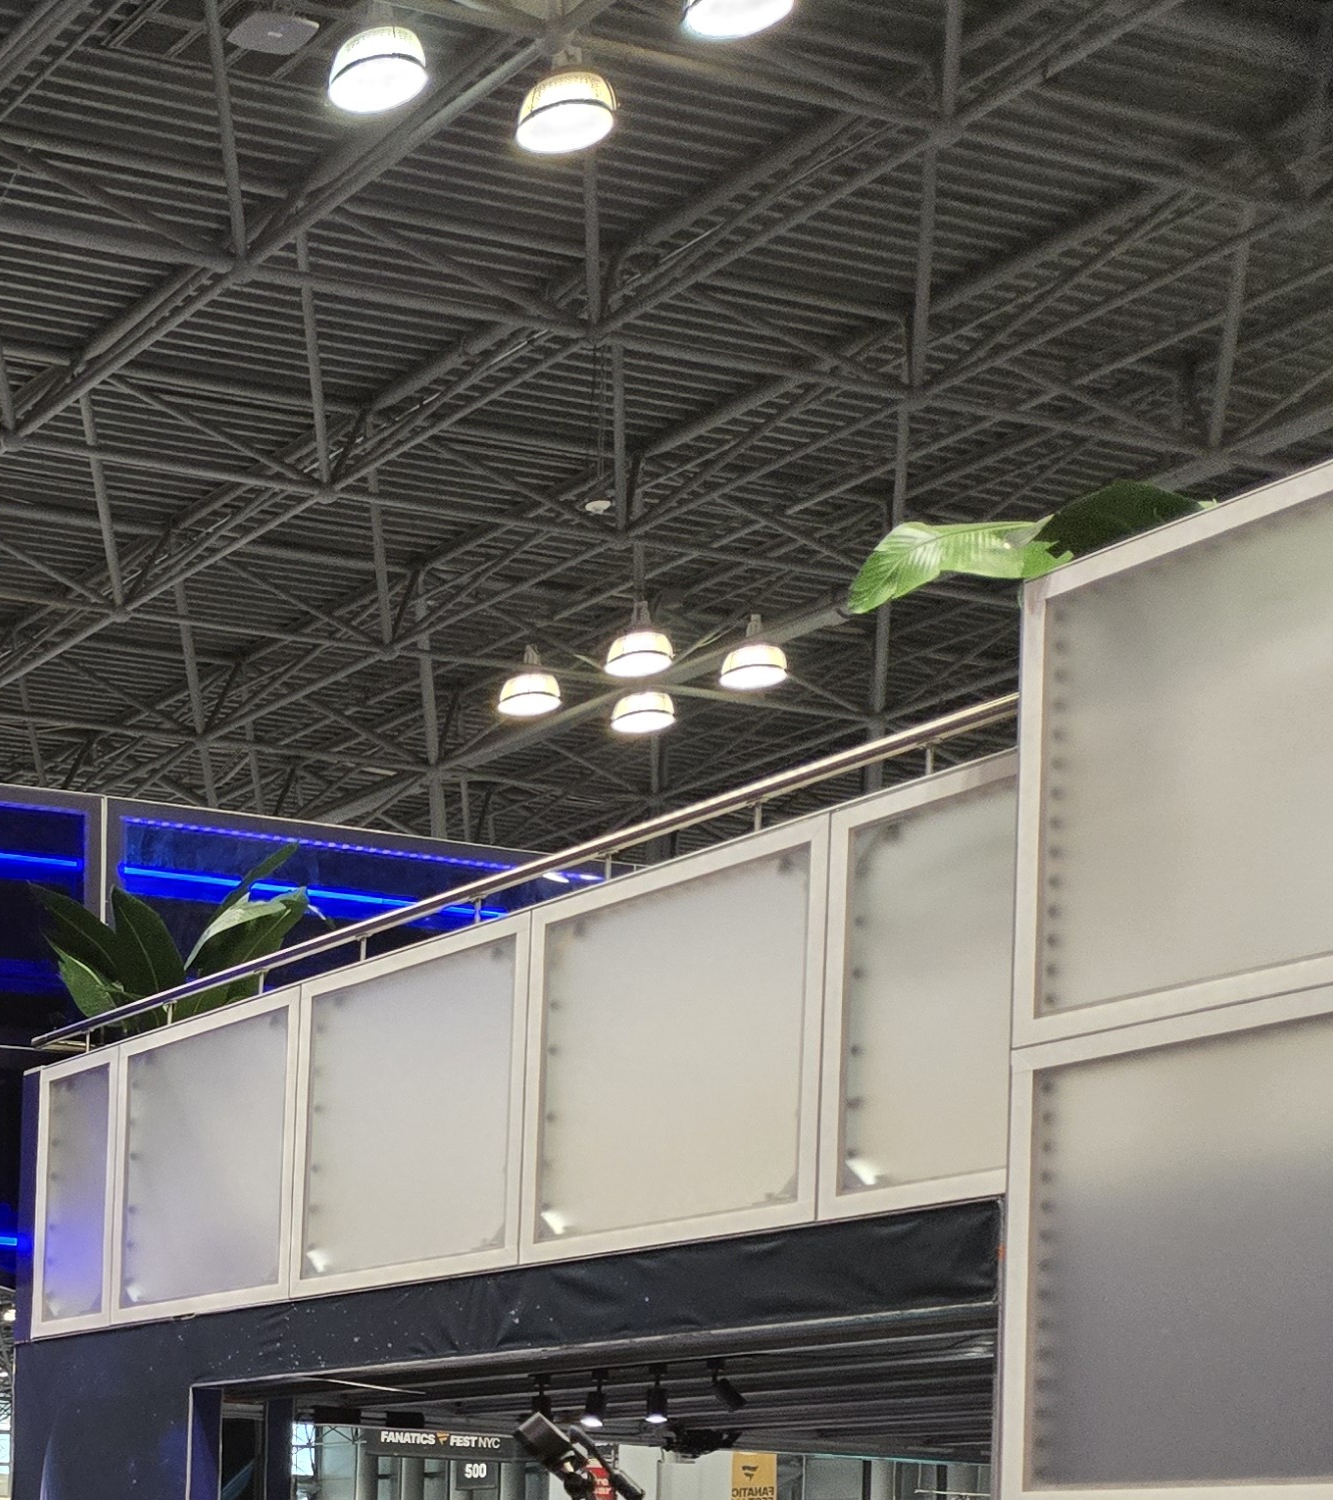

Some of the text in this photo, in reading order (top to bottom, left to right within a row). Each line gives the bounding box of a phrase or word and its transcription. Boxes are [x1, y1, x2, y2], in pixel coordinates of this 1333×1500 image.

[380, 1430, 501, 1449] FANATICS FEST NYC
[464, 1463, 487, 1479] 500
